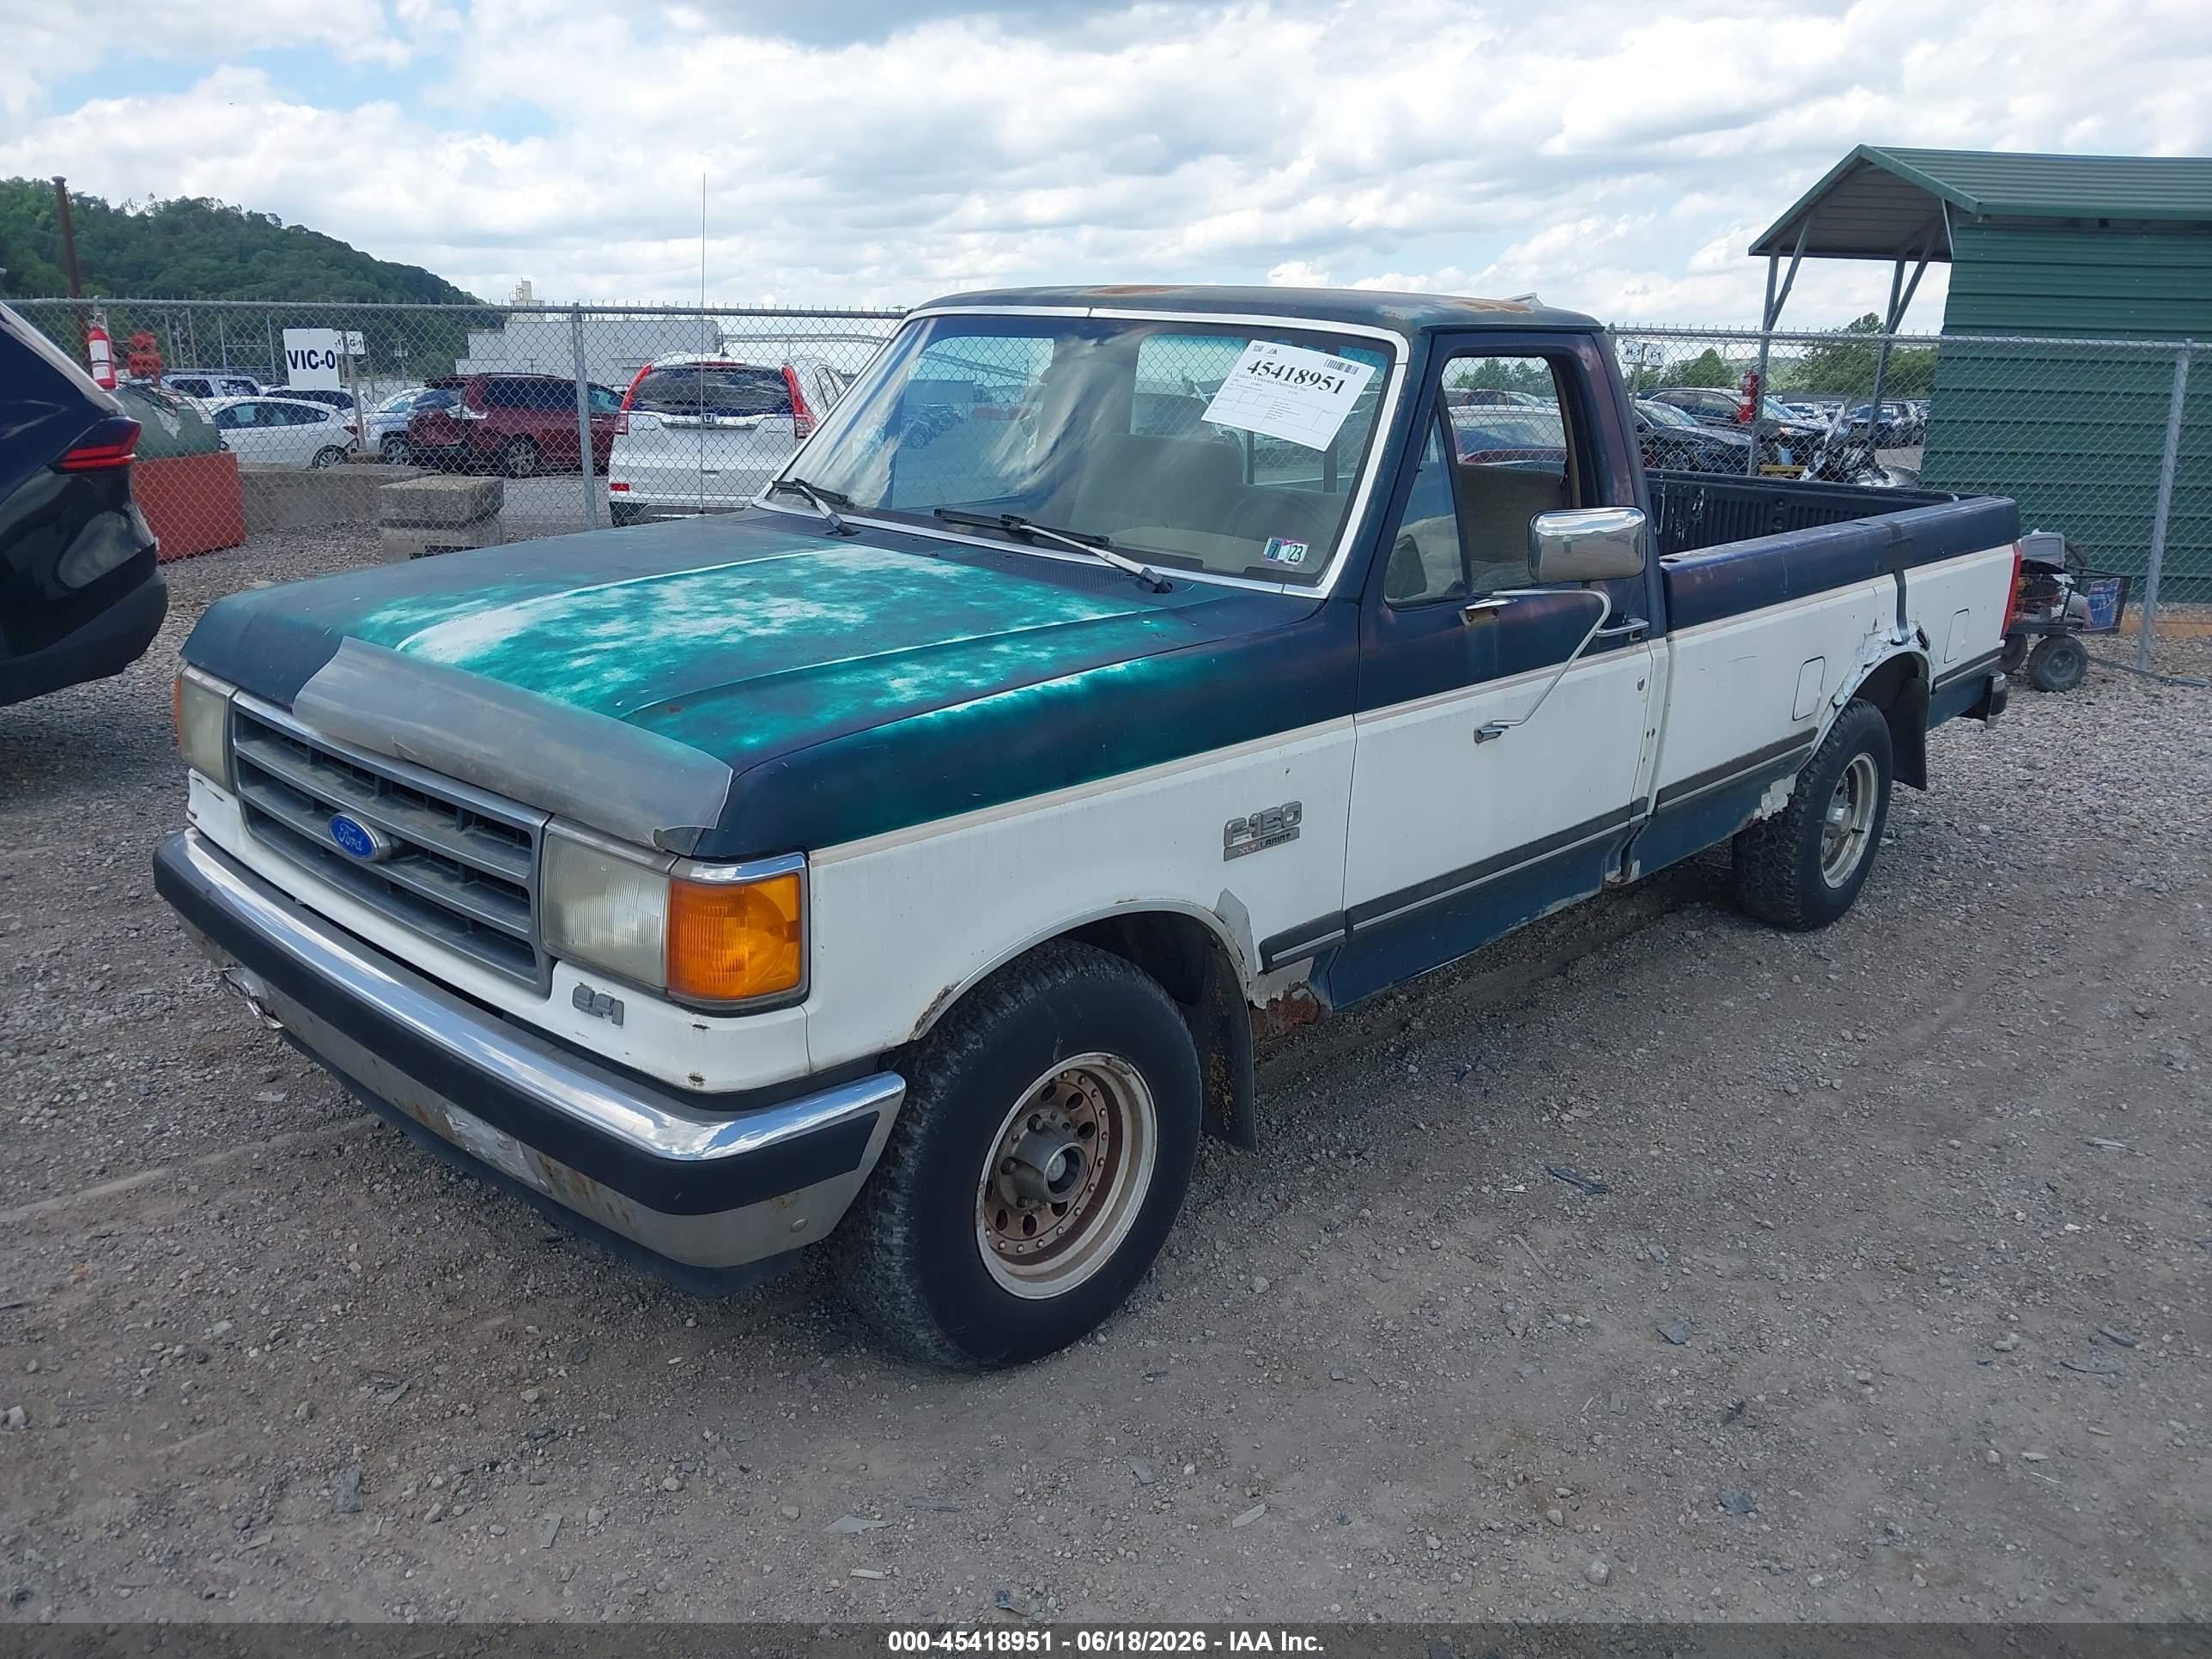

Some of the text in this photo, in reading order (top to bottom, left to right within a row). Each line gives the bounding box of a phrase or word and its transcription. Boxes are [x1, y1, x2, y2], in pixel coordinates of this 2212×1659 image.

[1626, 348, 1641, 356] H-1
[1246, 359, 1347, 396] 45418951
[1288, 544, 1304, 563] 23
[338, 823, 364, 852] Ford
[1224, 801, 1303, 848] F-150
[1237, 832, 1291, 856] XLT LARIAT
